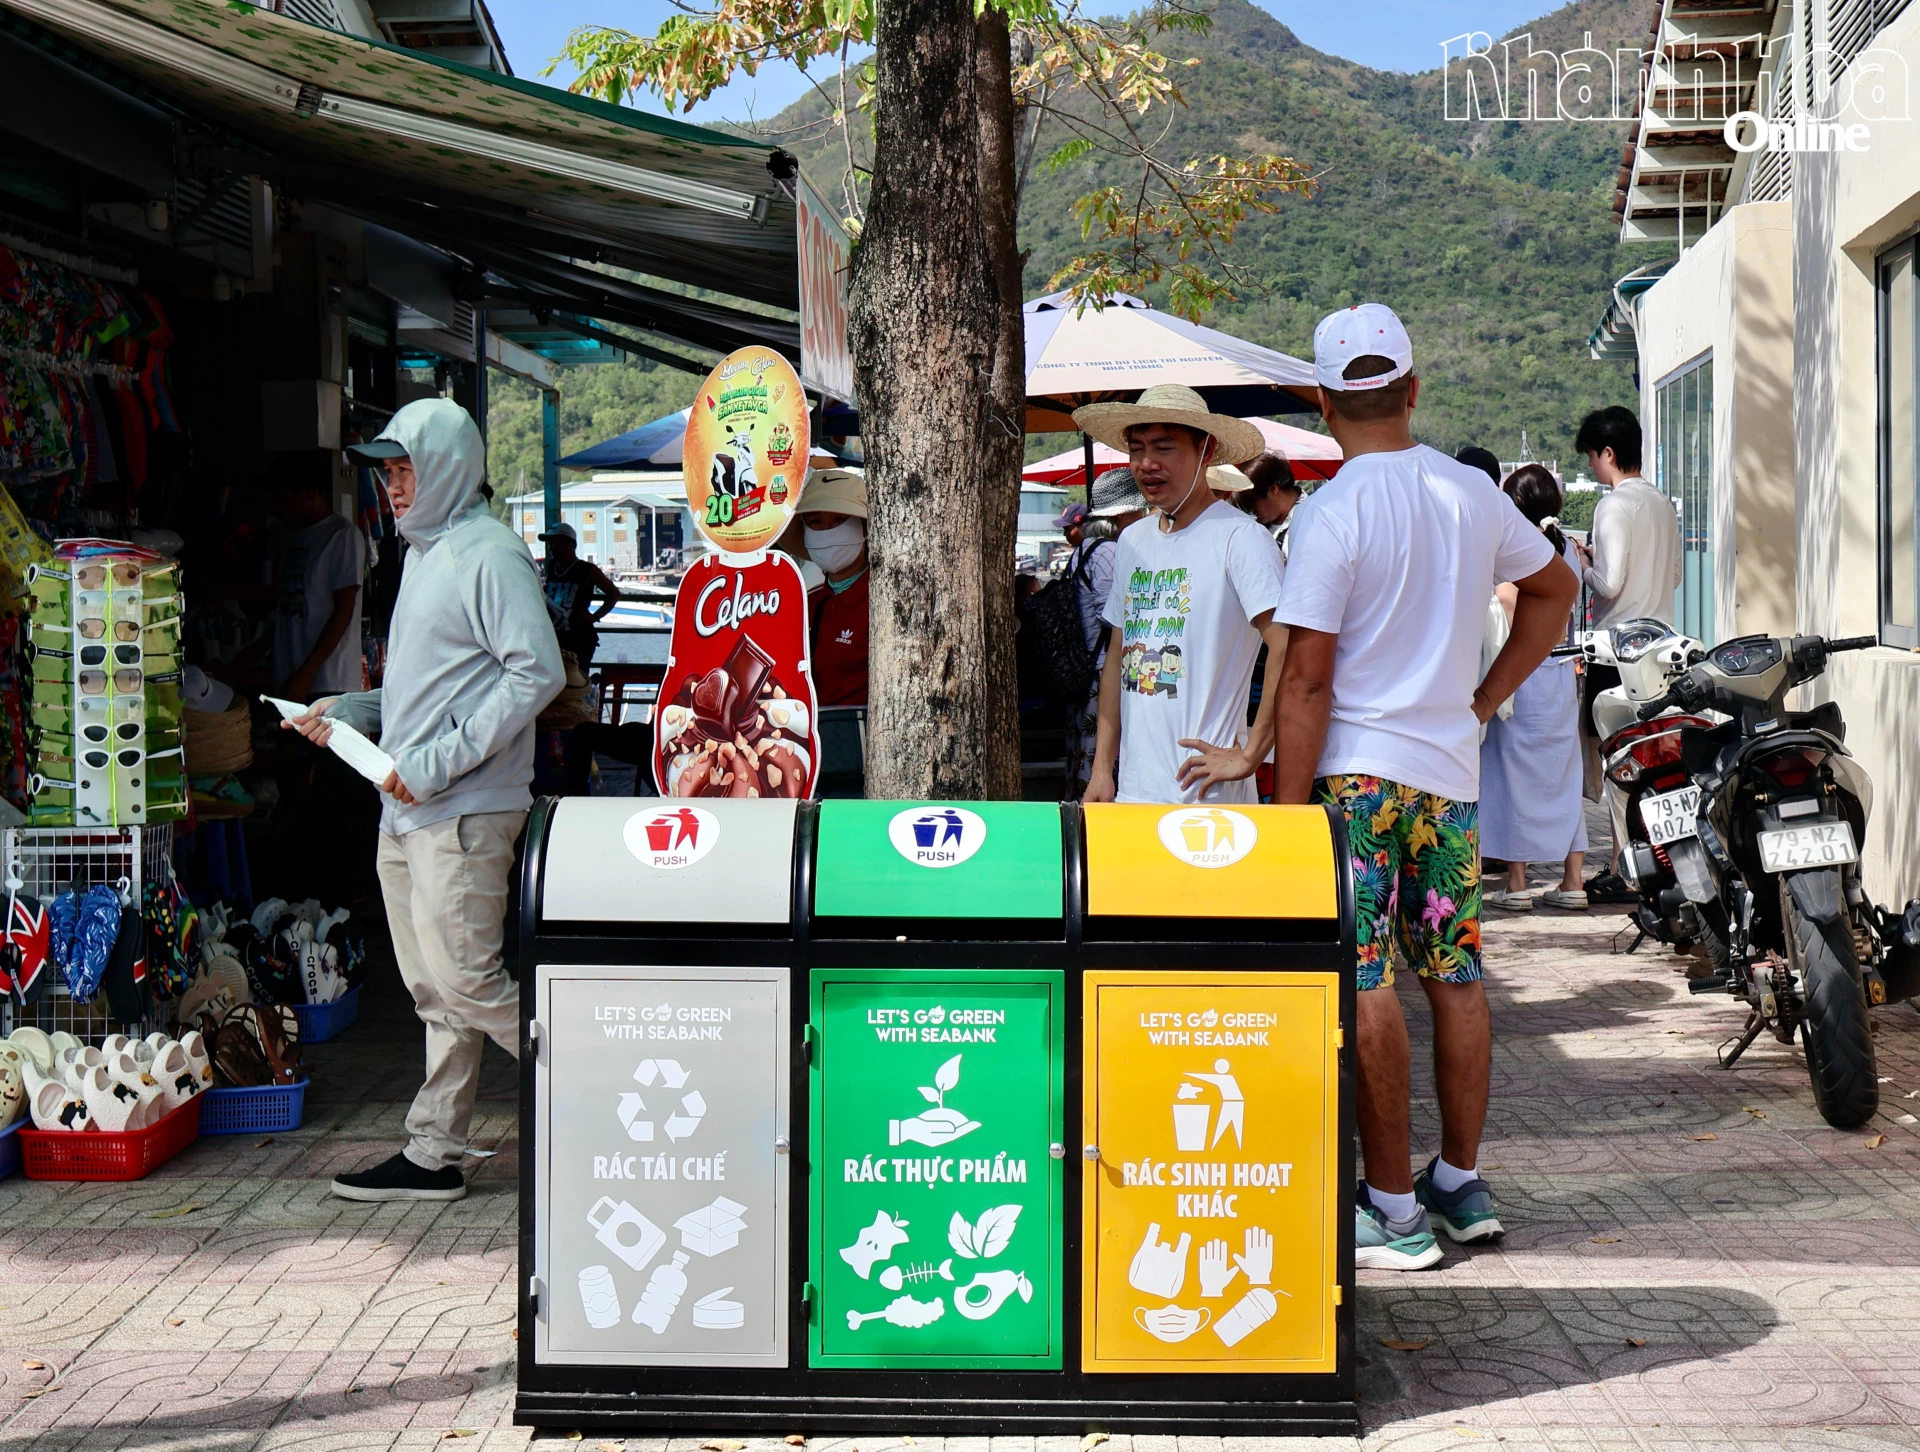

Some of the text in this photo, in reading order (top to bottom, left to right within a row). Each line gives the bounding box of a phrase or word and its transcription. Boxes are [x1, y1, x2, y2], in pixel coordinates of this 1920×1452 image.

[750, 355, 777, 376] Celano
[1036, 361, 1066, 369] CÔNG
[1114, 358, 1130, 366] DU
[705, 493, 733, 525] 20
[694, 571, 781, 639] Celano
[1652, 790, 1699, 819] 79-N2
[1651, 816, 1697, 841] 802.
[1772, 826, 1836, 848] 79-N2
[654, 855, 687, 866] PUSH
[917, 851, 956, 862] PUSH
[1191, 854, 1230, 863] PUSH
[1769, 841, 1851, 869] 242.01
[307, 956, 318, 996] crocs
[594, 1006, 636, 1021] LET'S
[676, 1007, 731, 1022] GREEN
[867, 1009, 909, 1024] LET'S
[949, 1009, 1004, 1024] GREEN
[1140, 1012, 1182, 1027] LET'S
[1222, 1013, 1277, 1027] GREEN
[603, 1024, 723, 1040] WITH SEABANK
[876, 1027, 996, 1043] WITH SEABANK
[1148, 1031, 1269, 1046] WITH SEABANK
[593, 1150, 728, 1181] RÁC TÁI CHẾ
[844, 1151, 1027, 1189] RÁC THỰC PHẨM
[1122, 1158, 1292, 1194] RÁC SINH HOẠT
[1177, 1190, 1238, 1218] KHÁC
